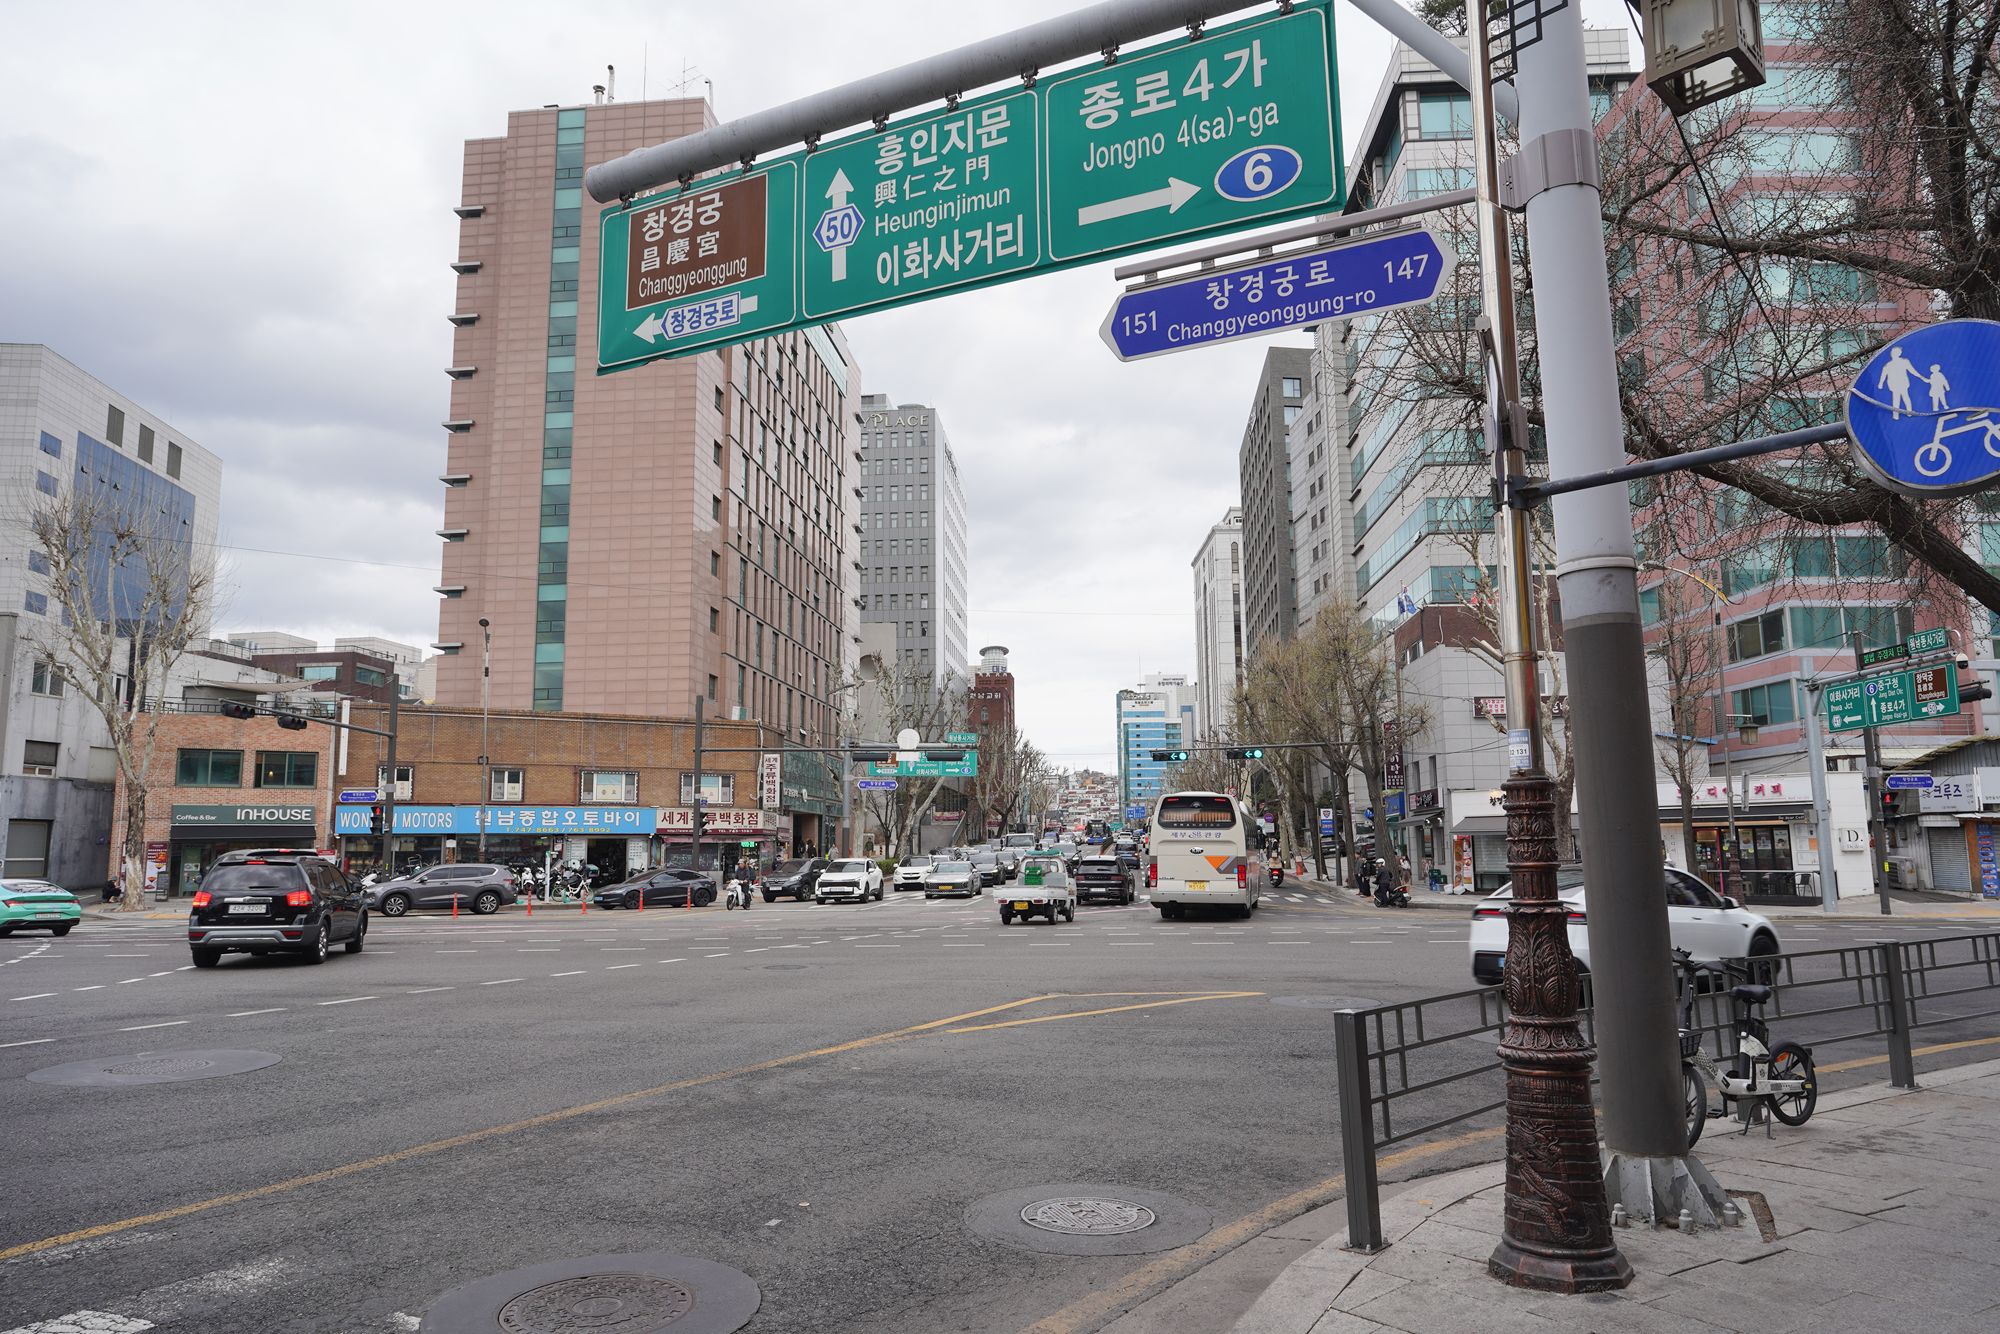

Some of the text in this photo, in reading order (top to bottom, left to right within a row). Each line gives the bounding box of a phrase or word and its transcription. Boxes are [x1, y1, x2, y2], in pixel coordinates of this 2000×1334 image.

[1079, 39, 1268, 130] 종로4가
[875, 105, 1009, 176] 흥인지문
[1083, 102, 1279, 172] Jongno 4(sa)-ga
[875, 154, 990, 208] 興仁之門
[1244, 152, 1274, 192] 6
[641, 193, 724, 242] 창경궁
[825, 213, 853, 242] 50
[875, 188, 1011, 237] Heunginjimun
[640, 231, 720, 273] 昌慶宮
[876, 215, 1024, 287] 이화사거리
[1383, 254, 1429, 284] 147
[638, 257, 748, 298] Changgyeonggung
[1205, 260, 1335, 311] 창경궁로
[670, 297, 737, 334] 창경궁로
[1122, 310, 1158, 337] 151
[1168, 289, 1376, 343] Changgyeonggung-ro
[1829, 686, 1860, 703] 이화사거리
[1869, 684, 1875, 694] 6
[1881, 699, 1906, 713] 종로4가
[1754, 783, 1782, 797] 커피
[402, 812, 453, 828] MOTORS
[475, 810, 640, 827] 원남종합오토바이
[661, 811, 759, 825] 세계류백화점
